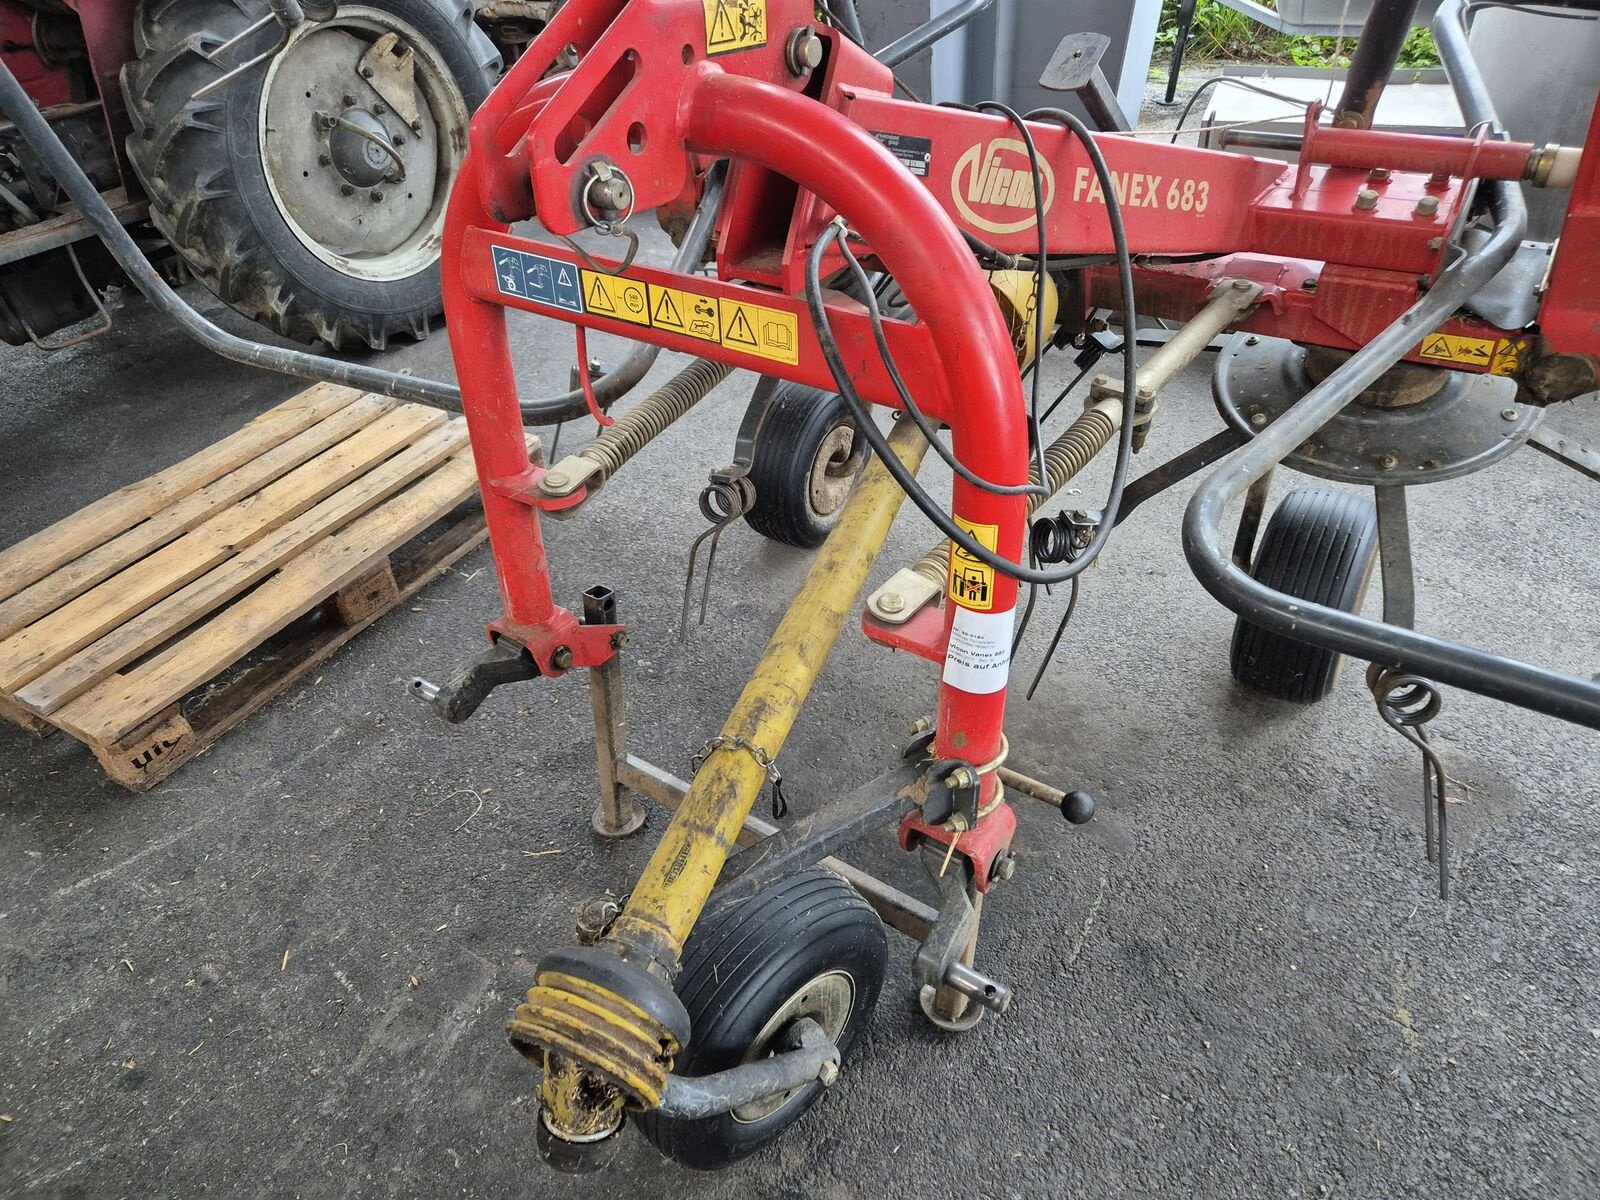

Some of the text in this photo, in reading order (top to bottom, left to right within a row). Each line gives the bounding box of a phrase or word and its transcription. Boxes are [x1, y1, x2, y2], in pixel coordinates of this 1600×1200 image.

[1073, 166, 1210, 213] FANEX 683
[949, 642, 969, 655] Vicon
[948, 653, 970, 667] Preis
